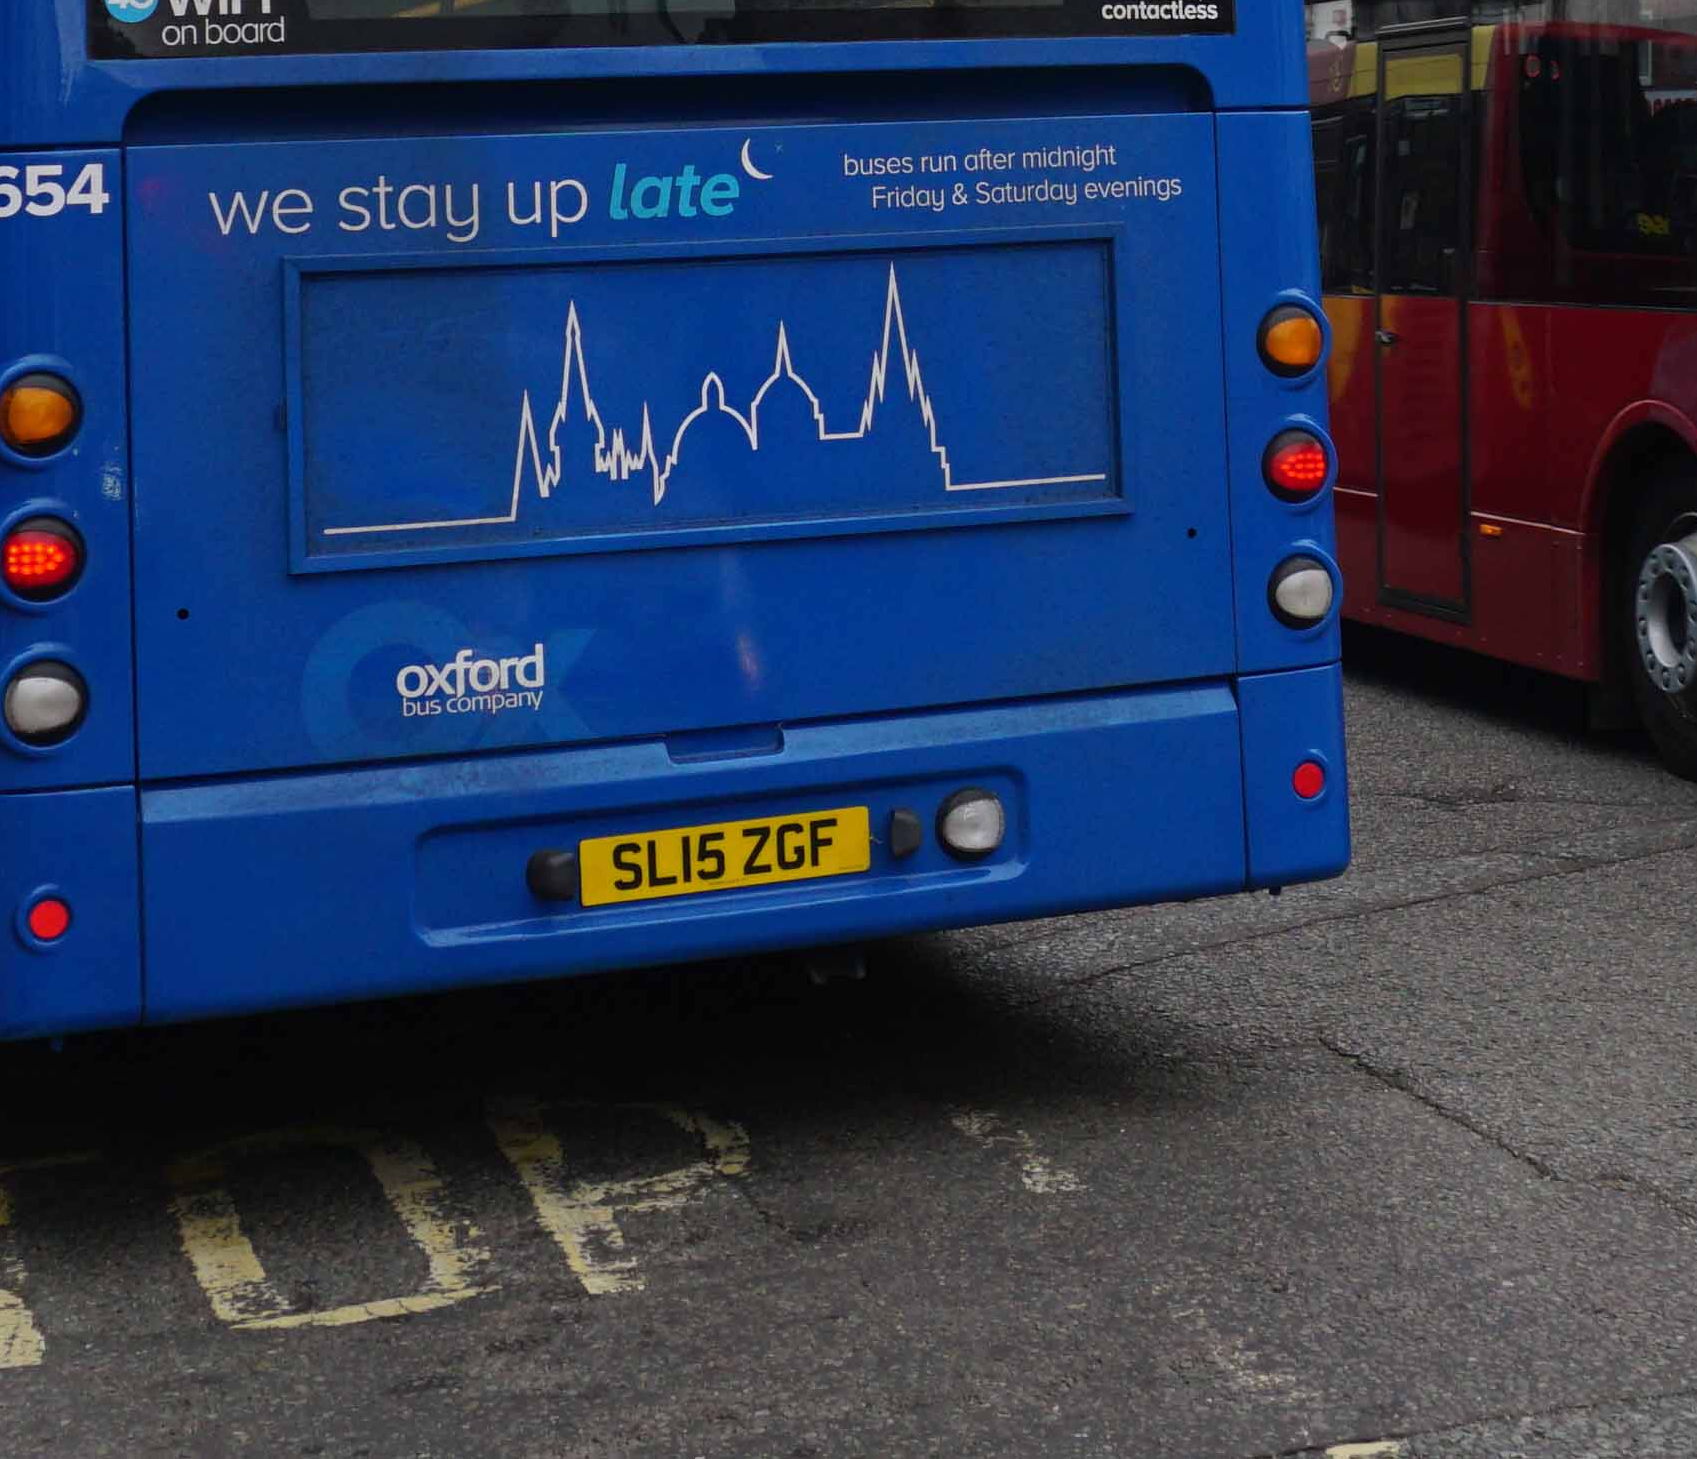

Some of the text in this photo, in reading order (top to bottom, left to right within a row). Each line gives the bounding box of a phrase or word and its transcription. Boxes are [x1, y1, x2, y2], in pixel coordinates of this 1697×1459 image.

[1101, 0, 1219, 20] contactless
[162, 16, 286, 46] on board
[843, 145, 1117, 176] buses run after midnight
[209, 162, 741, 243] we stay up late
[871, 176, 1183, 212] Friday & Saturday evenings
[396, 643, 545, 698] oxford
[403, 690, 544, 717] bus company
[611, 817, 839, 891] SL15 ZGF
